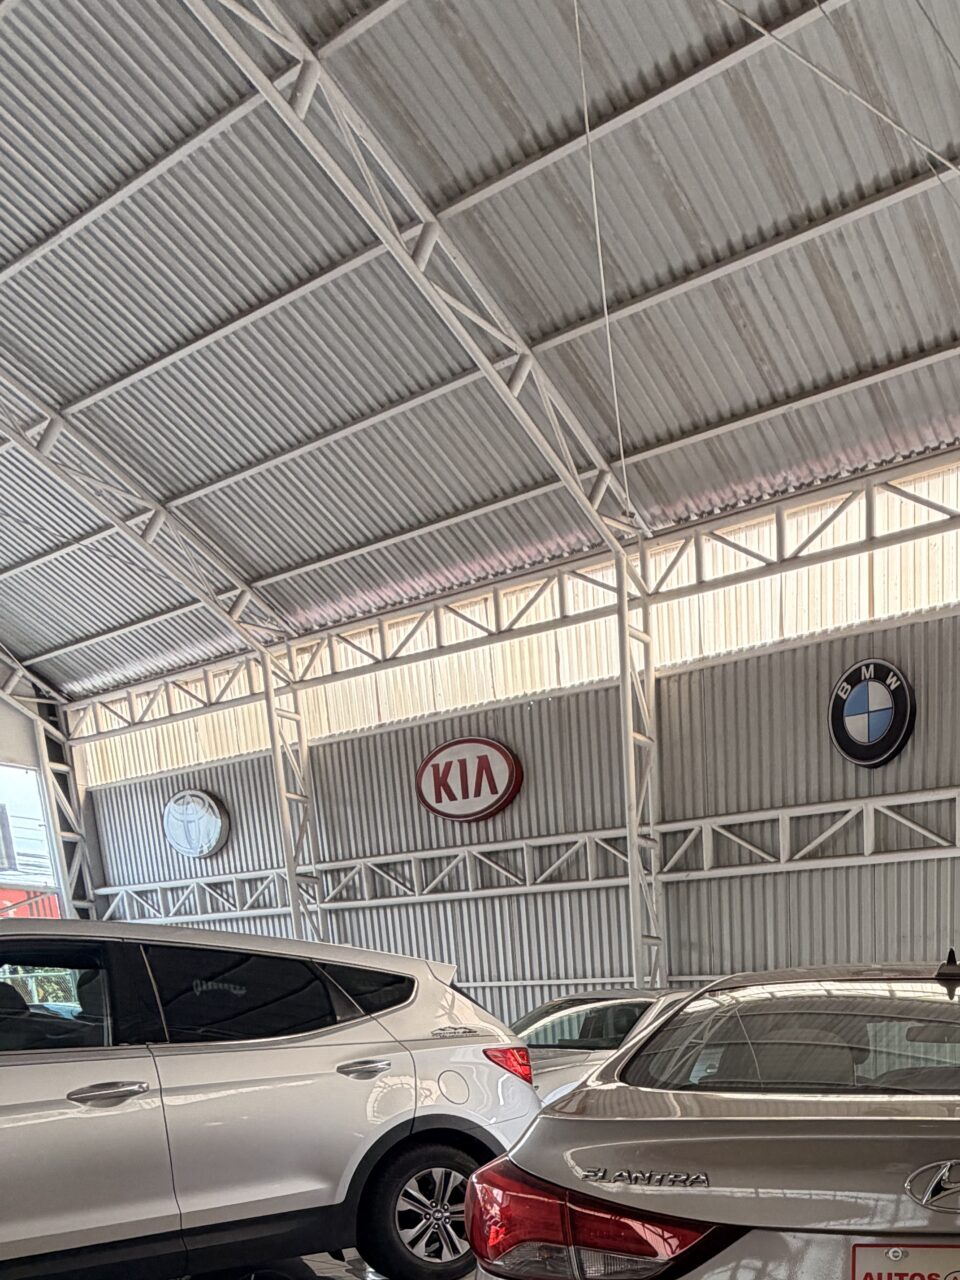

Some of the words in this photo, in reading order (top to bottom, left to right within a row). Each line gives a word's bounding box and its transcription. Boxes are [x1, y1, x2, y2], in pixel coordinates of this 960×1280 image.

[837, 664, 901, 700] BMW
[430, 754, 499, 804] KIA
[581, 1167, 710, 1187] ELANTRA
